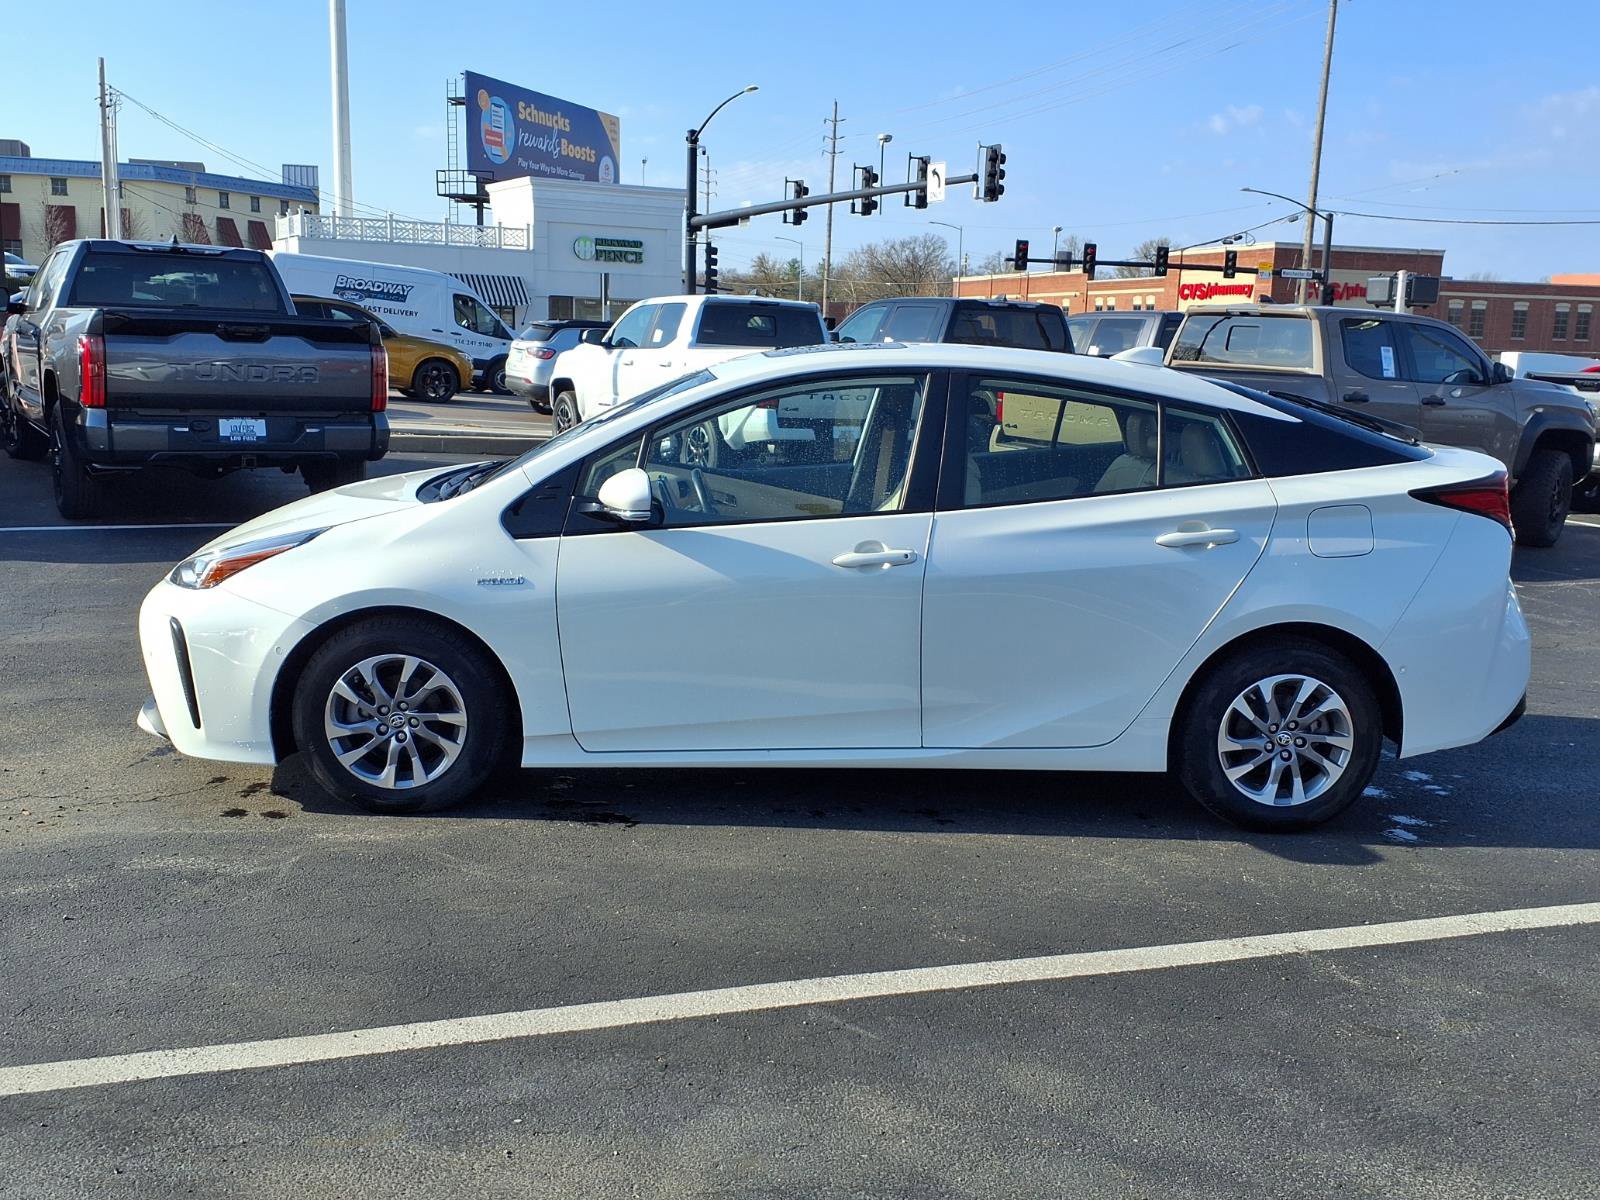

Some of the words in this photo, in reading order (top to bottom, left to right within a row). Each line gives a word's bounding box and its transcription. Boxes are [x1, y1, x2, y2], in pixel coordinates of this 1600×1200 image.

[518, 101, 571, 132] Schnucks
[518, 128, 560, 159] rewards
[561, 138, 596, 163] Boosts
[529, 160, 540, 169] Your
[540, 162, 550, 174] Way
[595, 249, 643, 264] FENCE
[336, 275, 413, 296] BROADWAY
[363, 304, 381, 313] FAST
[383, 307, 419, 317] DELIVERY
[167, 362, 320, 384] TUNDRA
[809, 393, 867, 401] TACO
[1020, 409, 1112, 427] TACOMA
